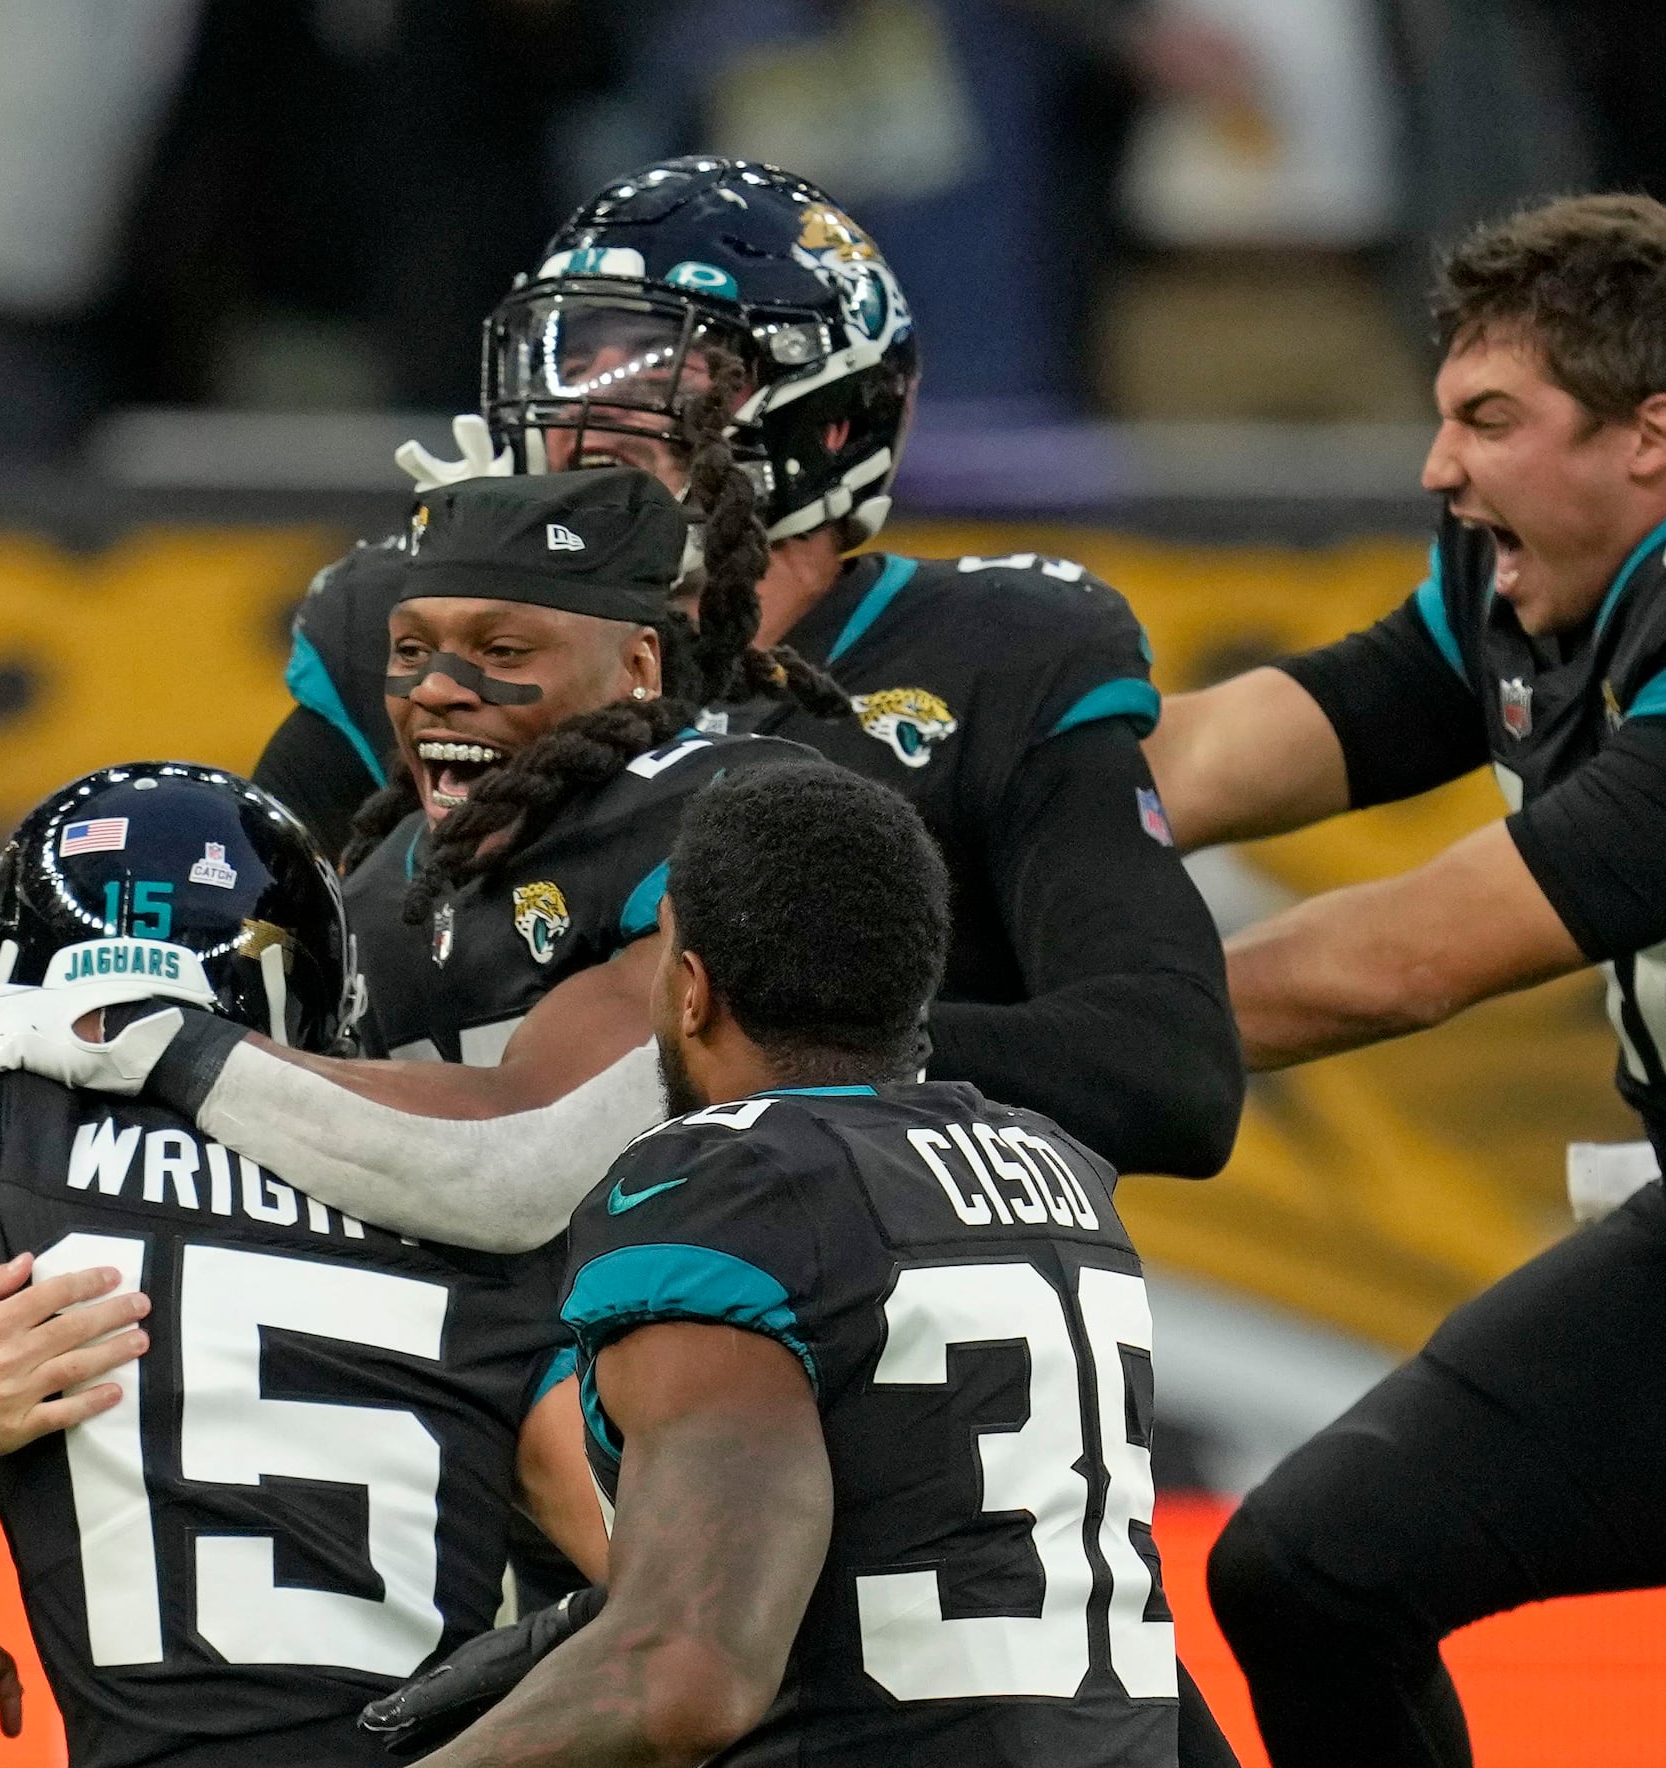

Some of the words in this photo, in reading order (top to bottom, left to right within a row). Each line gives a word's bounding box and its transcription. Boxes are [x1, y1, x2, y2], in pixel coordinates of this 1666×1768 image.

[103, 881, 174, 940] 15
[194, 865, 233, 881] CATCH
[64, 945, 180, 982] JAGUARS
[66, 1117, 420, 1248] WRIG
[906, 1122, 1099, 1231] CISCO
[32, 1232, 448, 1679] 15
